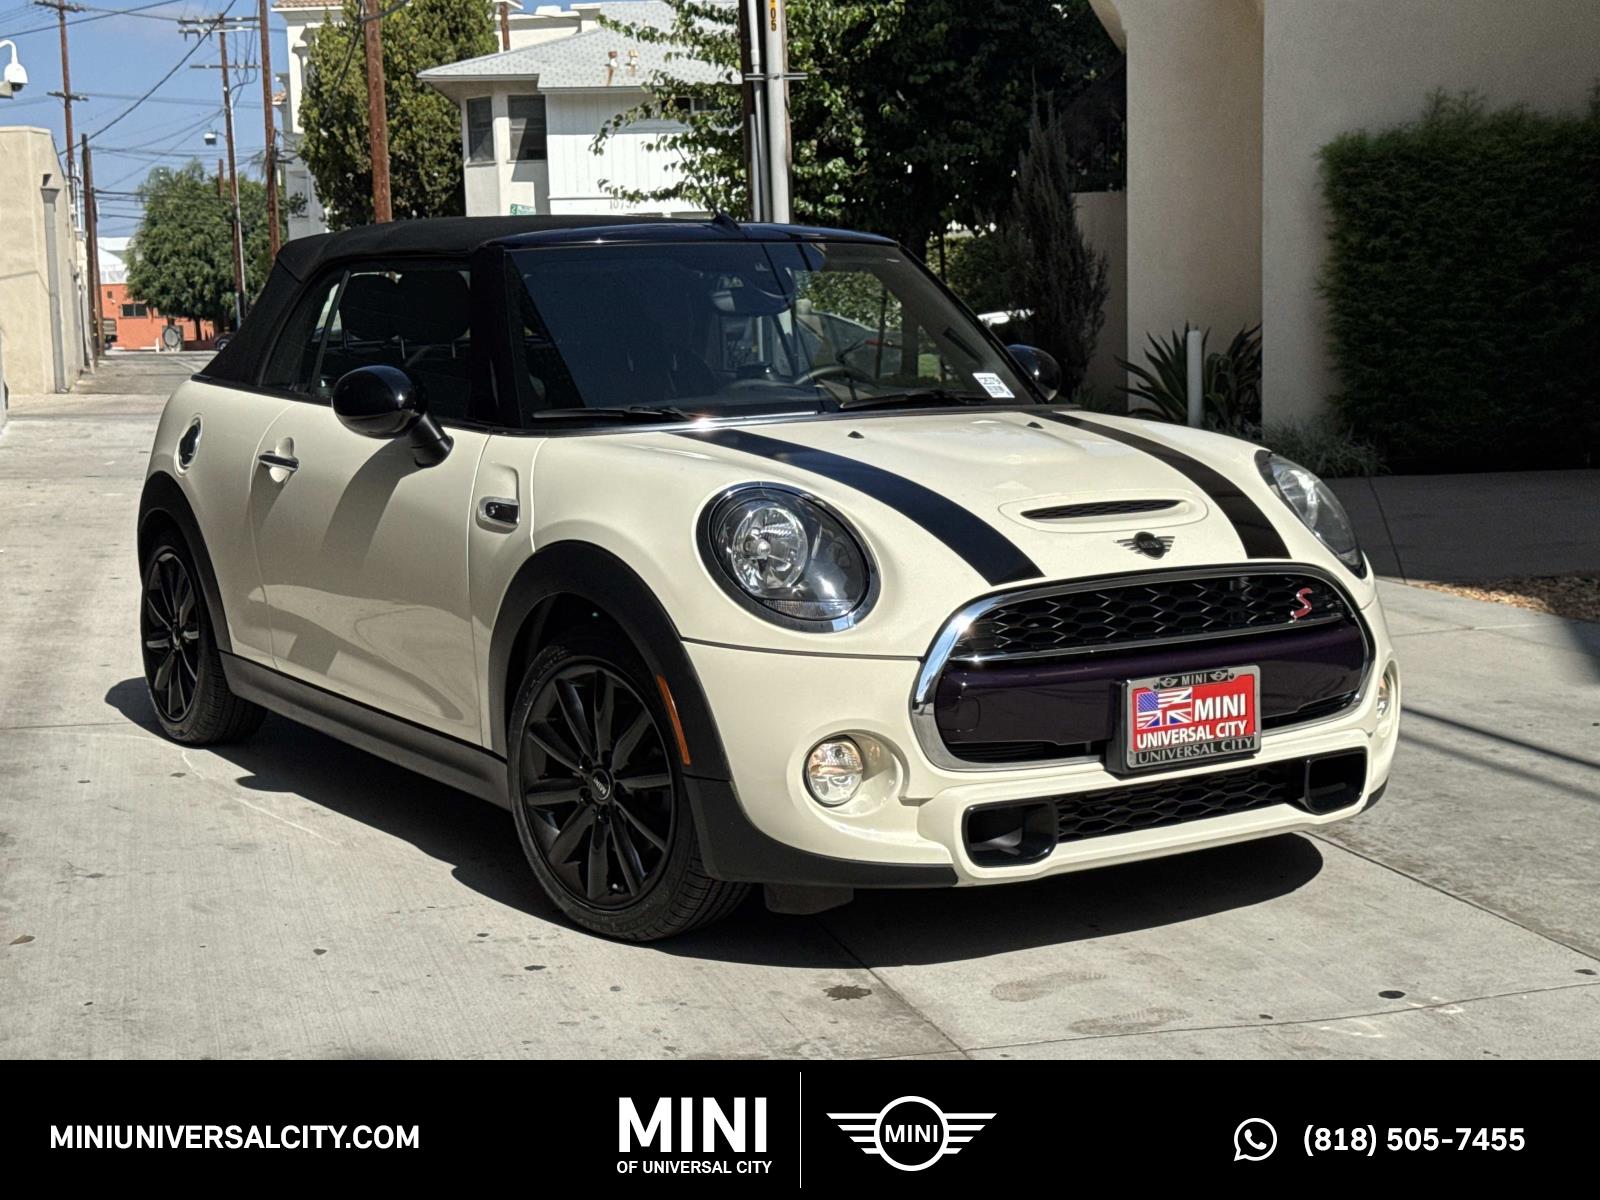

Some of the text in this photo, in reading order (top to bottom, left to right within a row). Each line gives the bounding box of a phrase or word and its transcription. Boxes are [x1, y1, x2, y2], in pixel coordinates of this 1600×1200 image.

[1290, 587, 1312, 619] S
[1181, 673, 1207, 686] MINI
[1194, 693, 1246, 722] MINI
[1136, 720, 1248, 749] UNIVERSAL CITY
[1138, 737, 1253, 764] UNIVERSAL CITY
